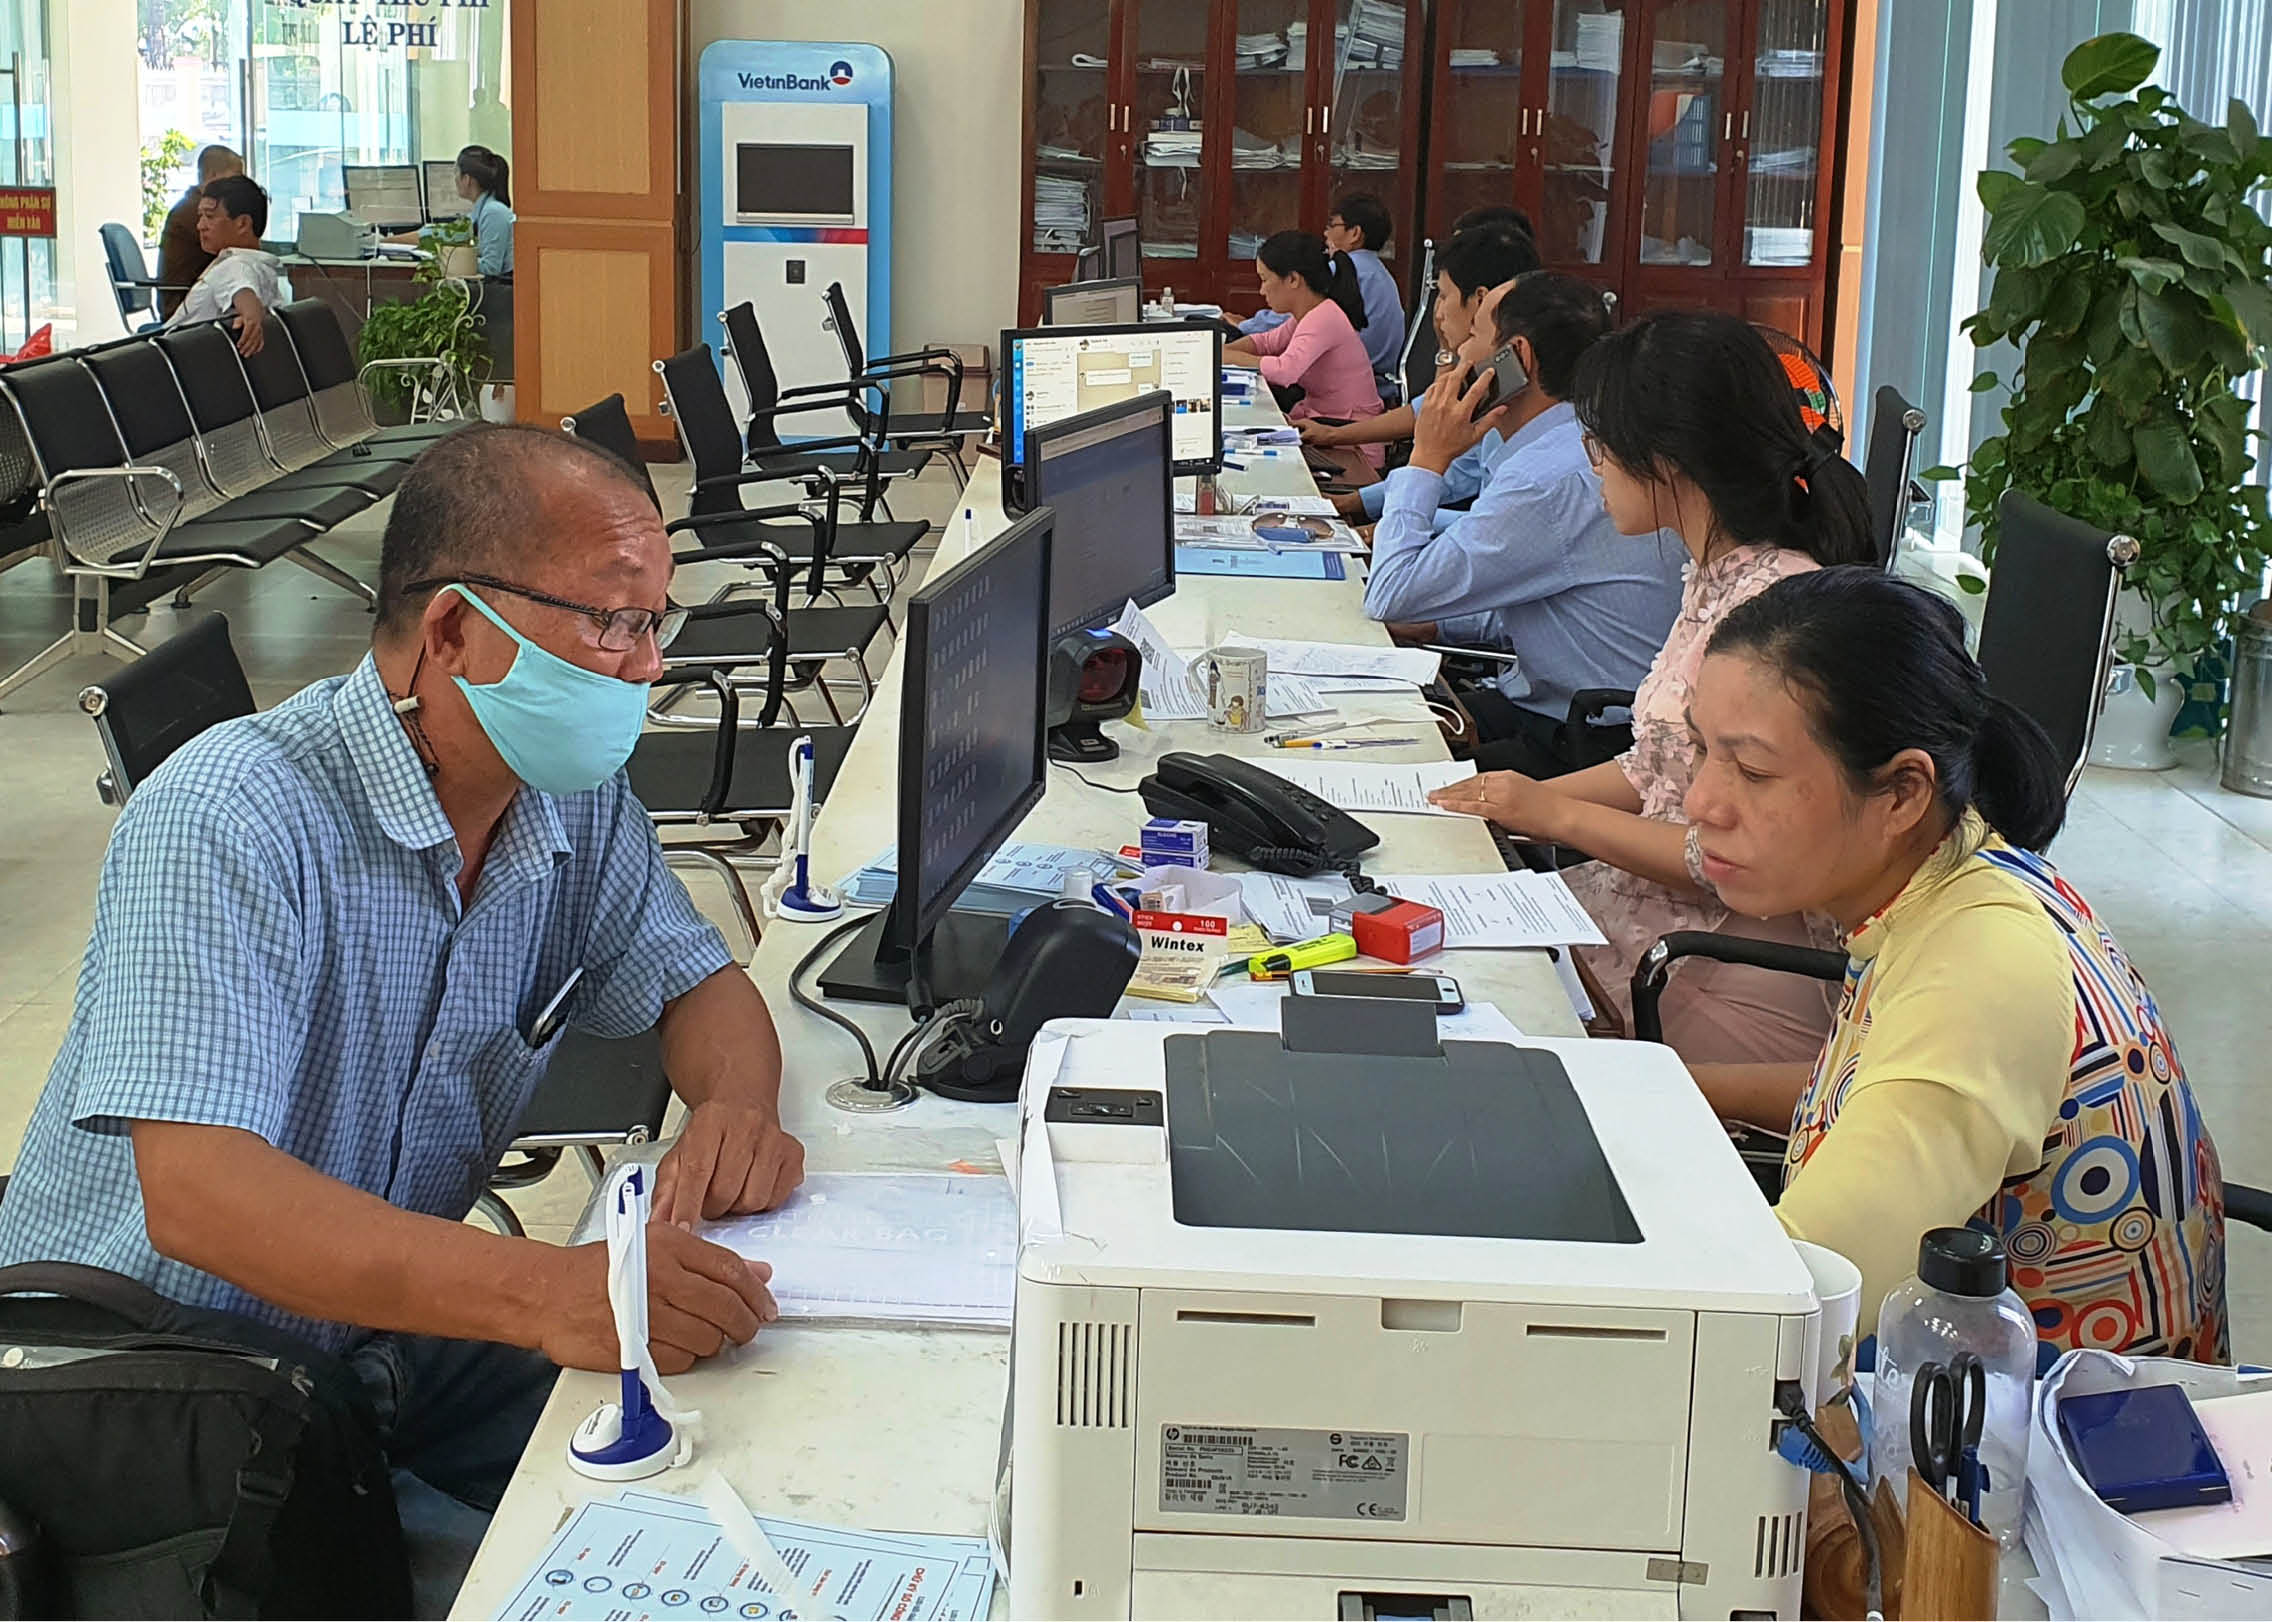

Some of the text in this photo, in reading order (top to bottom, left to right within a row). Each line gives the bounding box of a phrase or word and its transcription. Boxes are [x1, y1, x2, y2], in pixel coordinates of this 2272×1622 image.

[342, 14, 377, 50] LỆ
[387, 16, 437, 46] PHÍ
[738, 72, 831, 91] VietinBank
[1200, 920, 1215, 928] 100
[1151, 935, 1205, 952] Wintex
